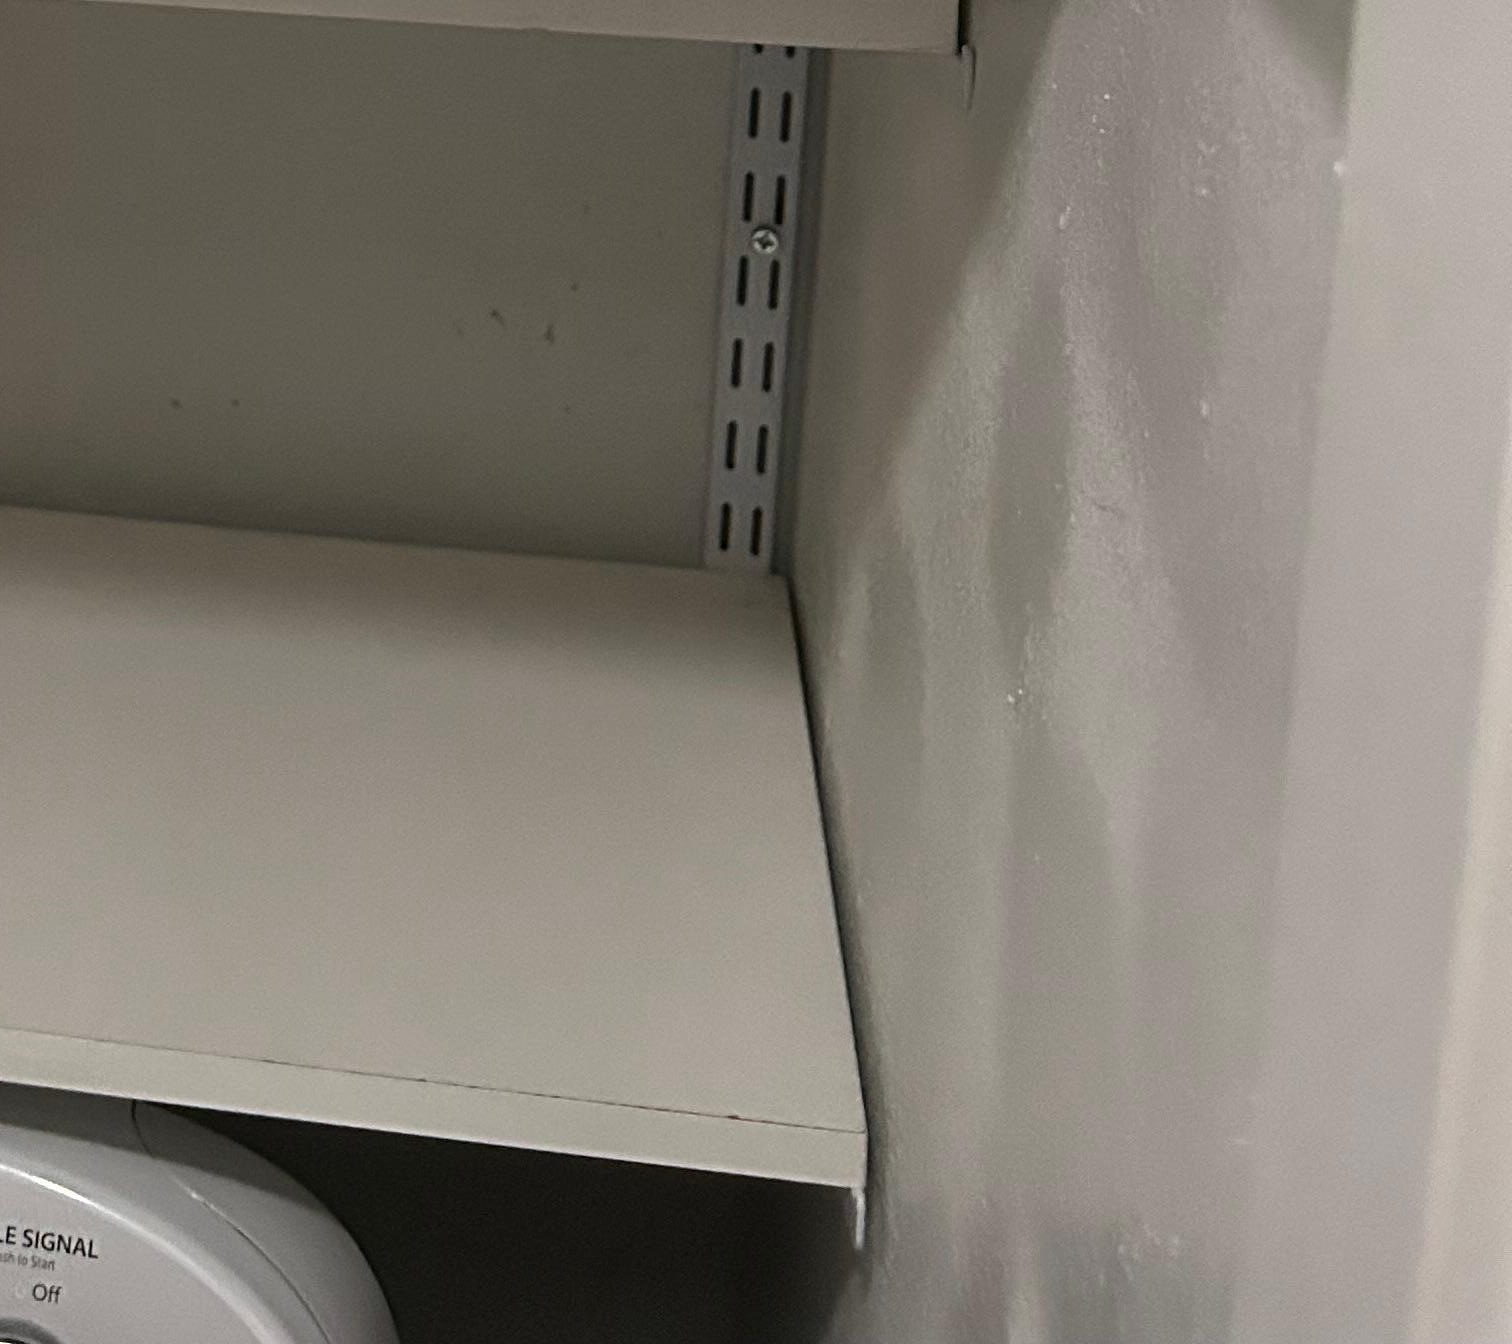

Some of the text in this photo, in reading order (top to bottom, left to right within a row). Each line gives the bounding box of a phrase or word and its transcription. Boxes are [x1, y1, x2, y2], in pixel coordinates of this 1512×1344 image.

[21, 1228, 99, 1260] SIGNAL
[31, 1254, 56, 1272] Start
[31, 1282, 63, 1305] Off
